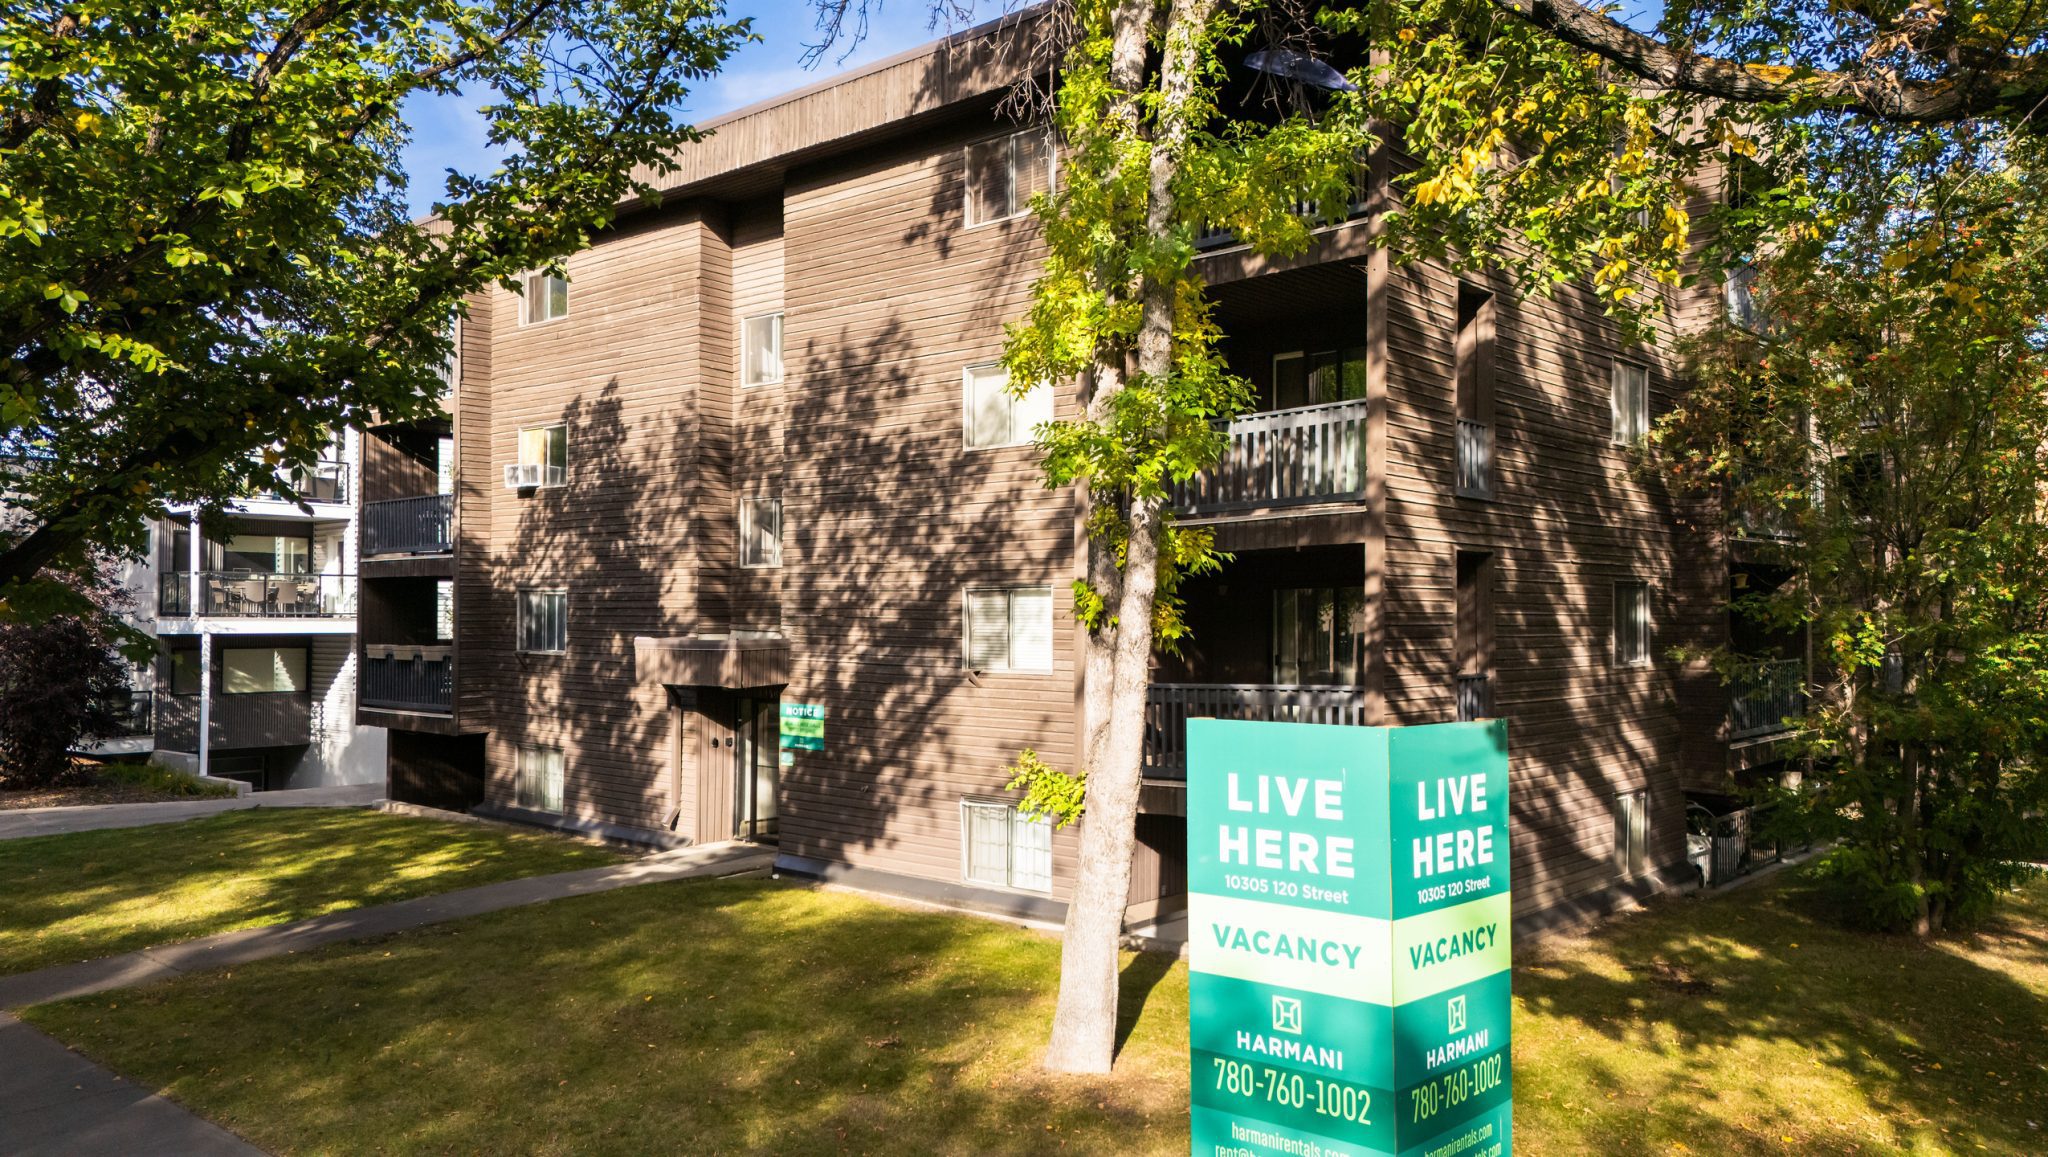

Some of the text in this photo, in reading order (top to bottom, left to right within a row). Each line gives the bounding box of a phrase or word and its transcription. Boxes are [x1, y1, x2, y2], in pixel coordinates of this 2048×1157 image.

[786, 707, 818, 717] NOTICE
[1227, 772, 1344, 821] LIVE
[1417, 773, 1487, 821] LIVE
[1219, 824, 1355, 879] HERE
[1412, 825, 1494, 879] HERE
[1224, 874, 1349, 905] 10305 120 Street
[1417, 875, 1491, 904] 10305 120 Street
[1212, 923, 1362, 969] VACANCY
[1409, 923, 1497, 970] VACANCY
[1236, 1030, 1343, 1071] HARMANI
[1426, 1028, 1489, 1070] HARMANI
[1213, 1058, 1372, 1126] 780-760-1002
[1411, 1053, 1502, 1124] 780-760-1002
[1231, 1121, 1351, 1157] harmanirentalsco
